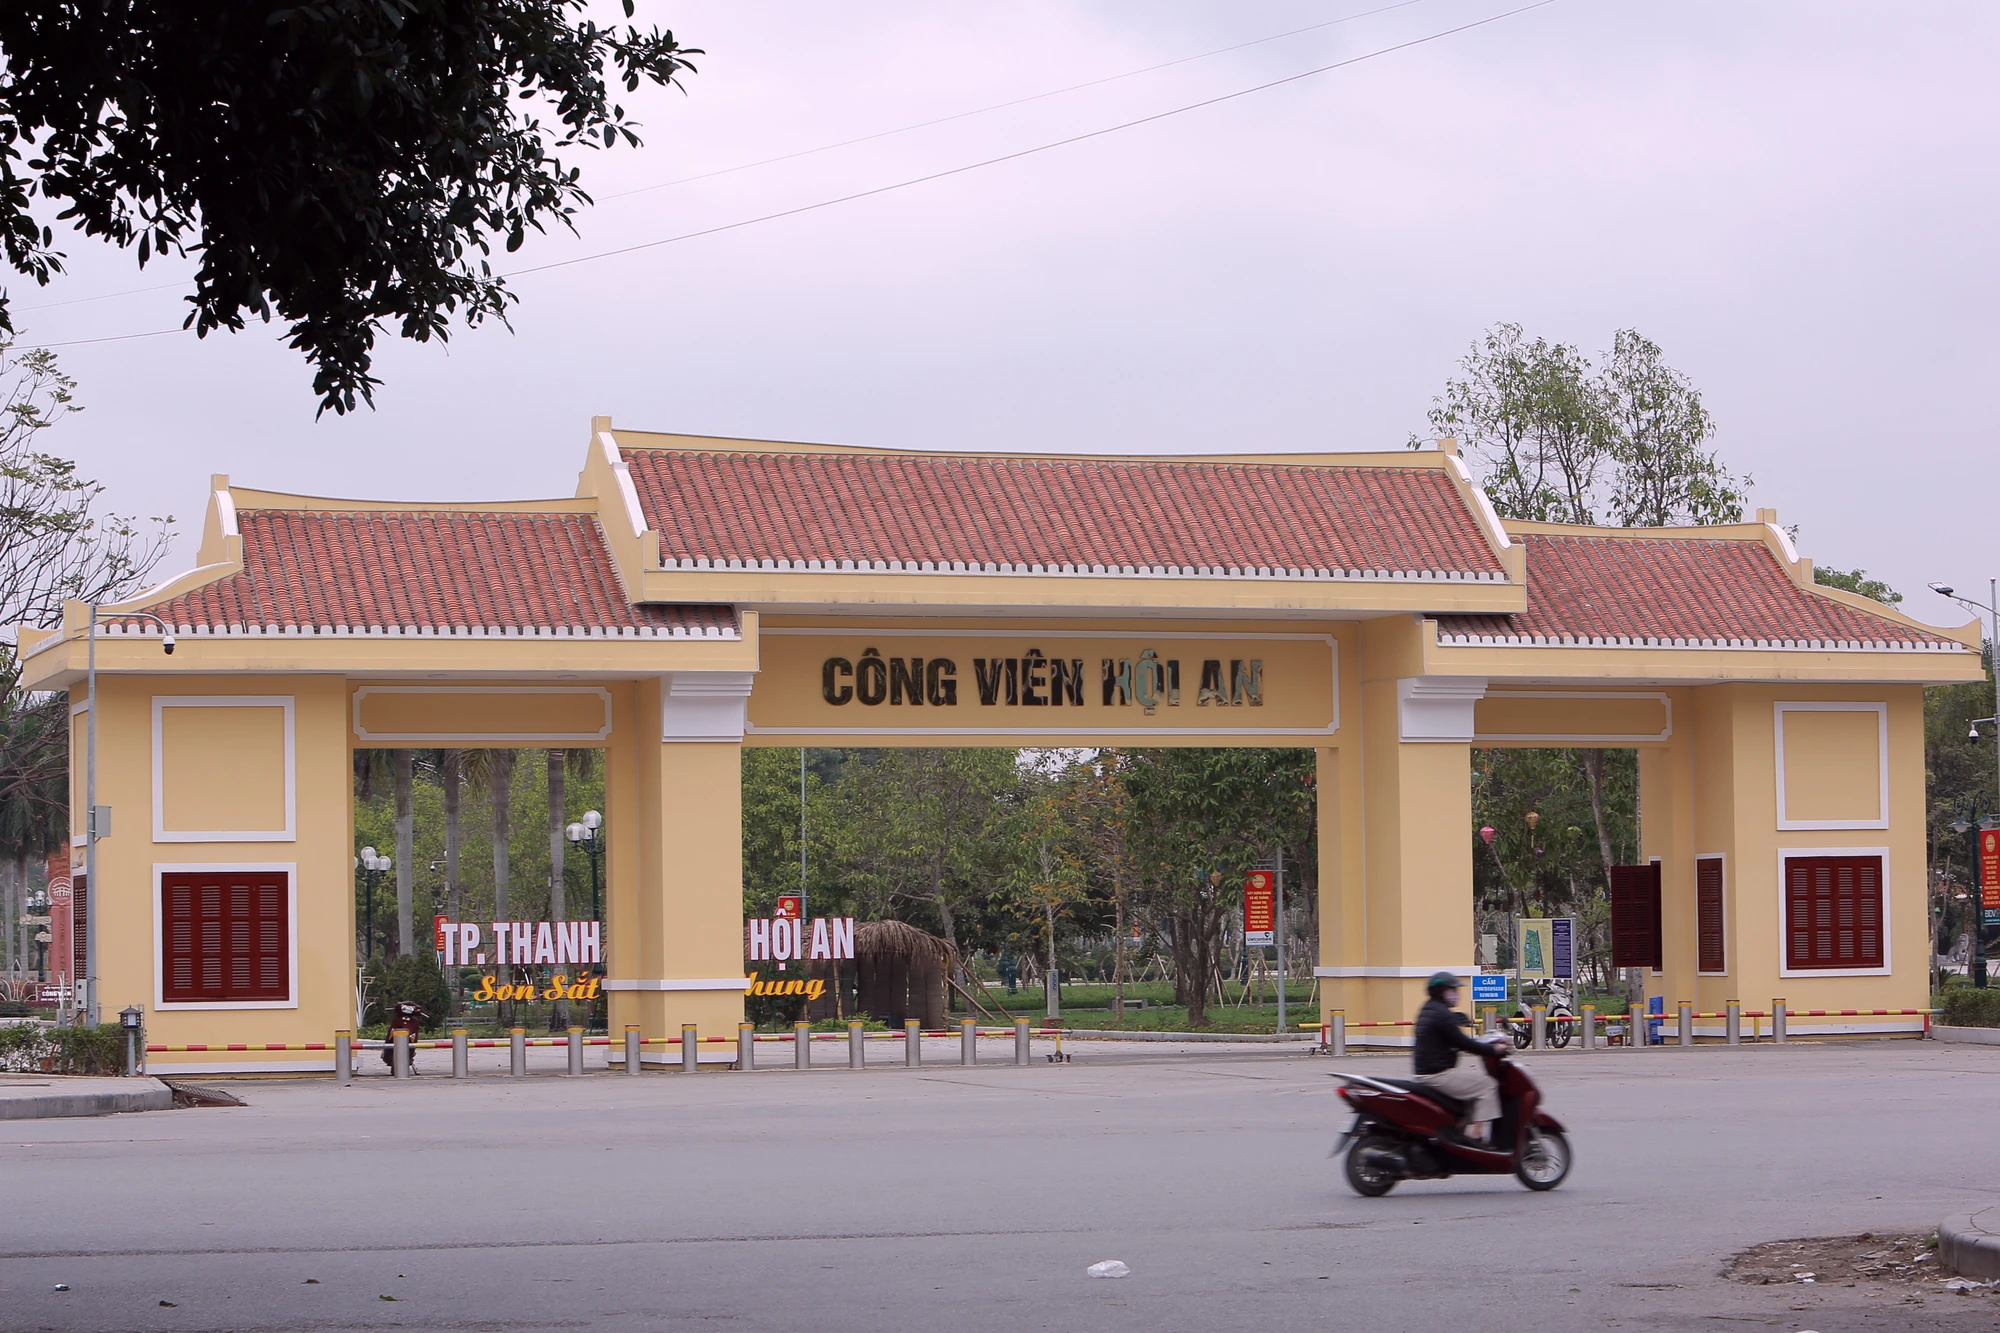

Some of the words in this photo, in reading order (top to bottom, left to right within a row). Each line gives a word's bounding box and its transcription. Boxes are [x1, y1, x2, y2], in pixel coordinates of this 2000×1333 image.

[822, 647, 957, 706] CÔNG
[973, 648, 1084, 706] VIÊN
[1102, 649, 1180, 716] HỘI
[1196, 660, 1263, 706] AN
[441, 922, 486, 965] TP.
[492, 920, 600, 964] THANH
[749, 908, 802, 970] HỘI
[810, 917, 855, 960] AN
[473, 975, 537, 1001] Son
[543, 970, 600, 1000] Sắt
[744, 971, 827, 1001] hung
[1482, 977, 1496, 985] CẤM
